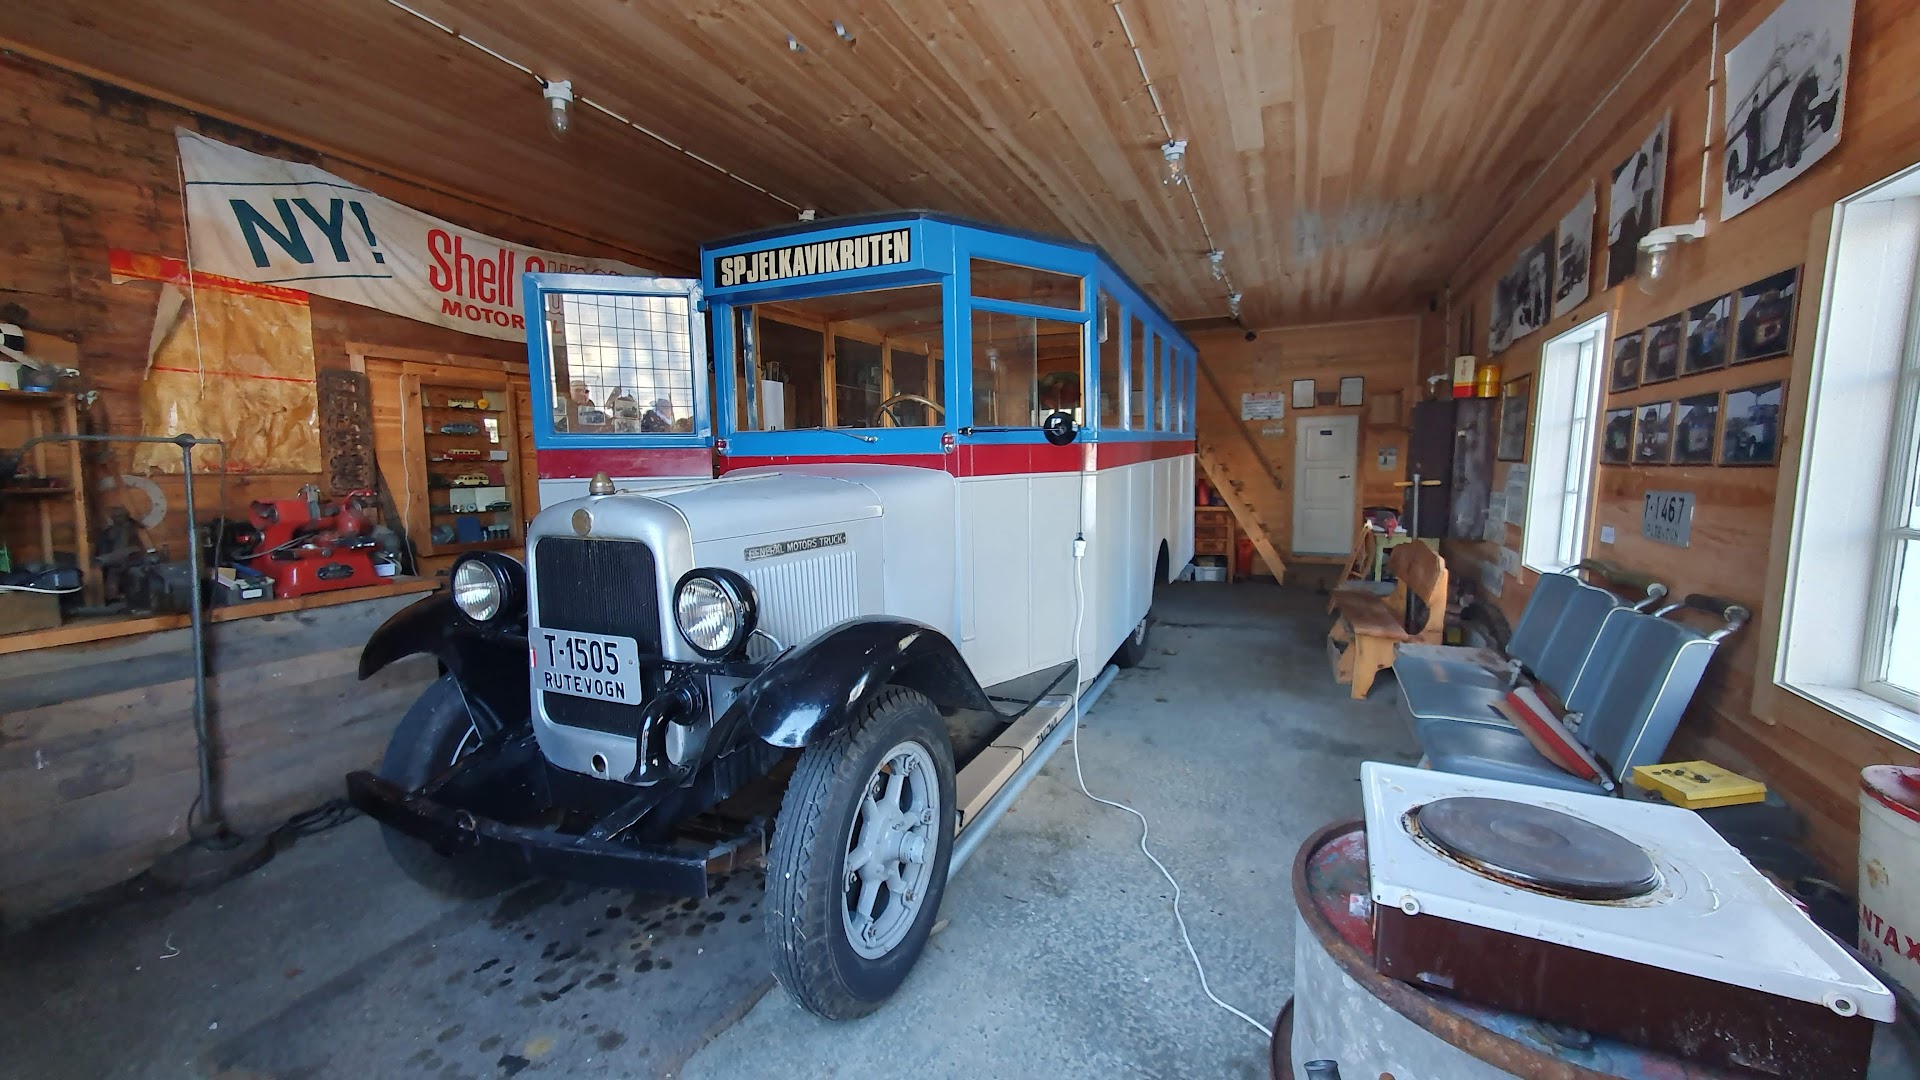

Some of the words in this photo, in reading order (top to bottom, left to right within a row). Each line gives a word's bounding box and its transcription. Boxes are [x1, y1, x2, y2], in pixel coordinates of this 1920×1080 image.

[228, 198, 385, 268] NY!
[427, 228, 515, 308] Shell
[721, 230, 909, 287] SPJELKAVIKRUTEN
[441, 298, 525, 330] MOTOR
[786, 538, 817, 552] MOTORS
[819, 534, 843, 547] TRUCK
[543, 634, 619, 675] T-1505
[544, 671, 626, 700] RUTEVOGN
